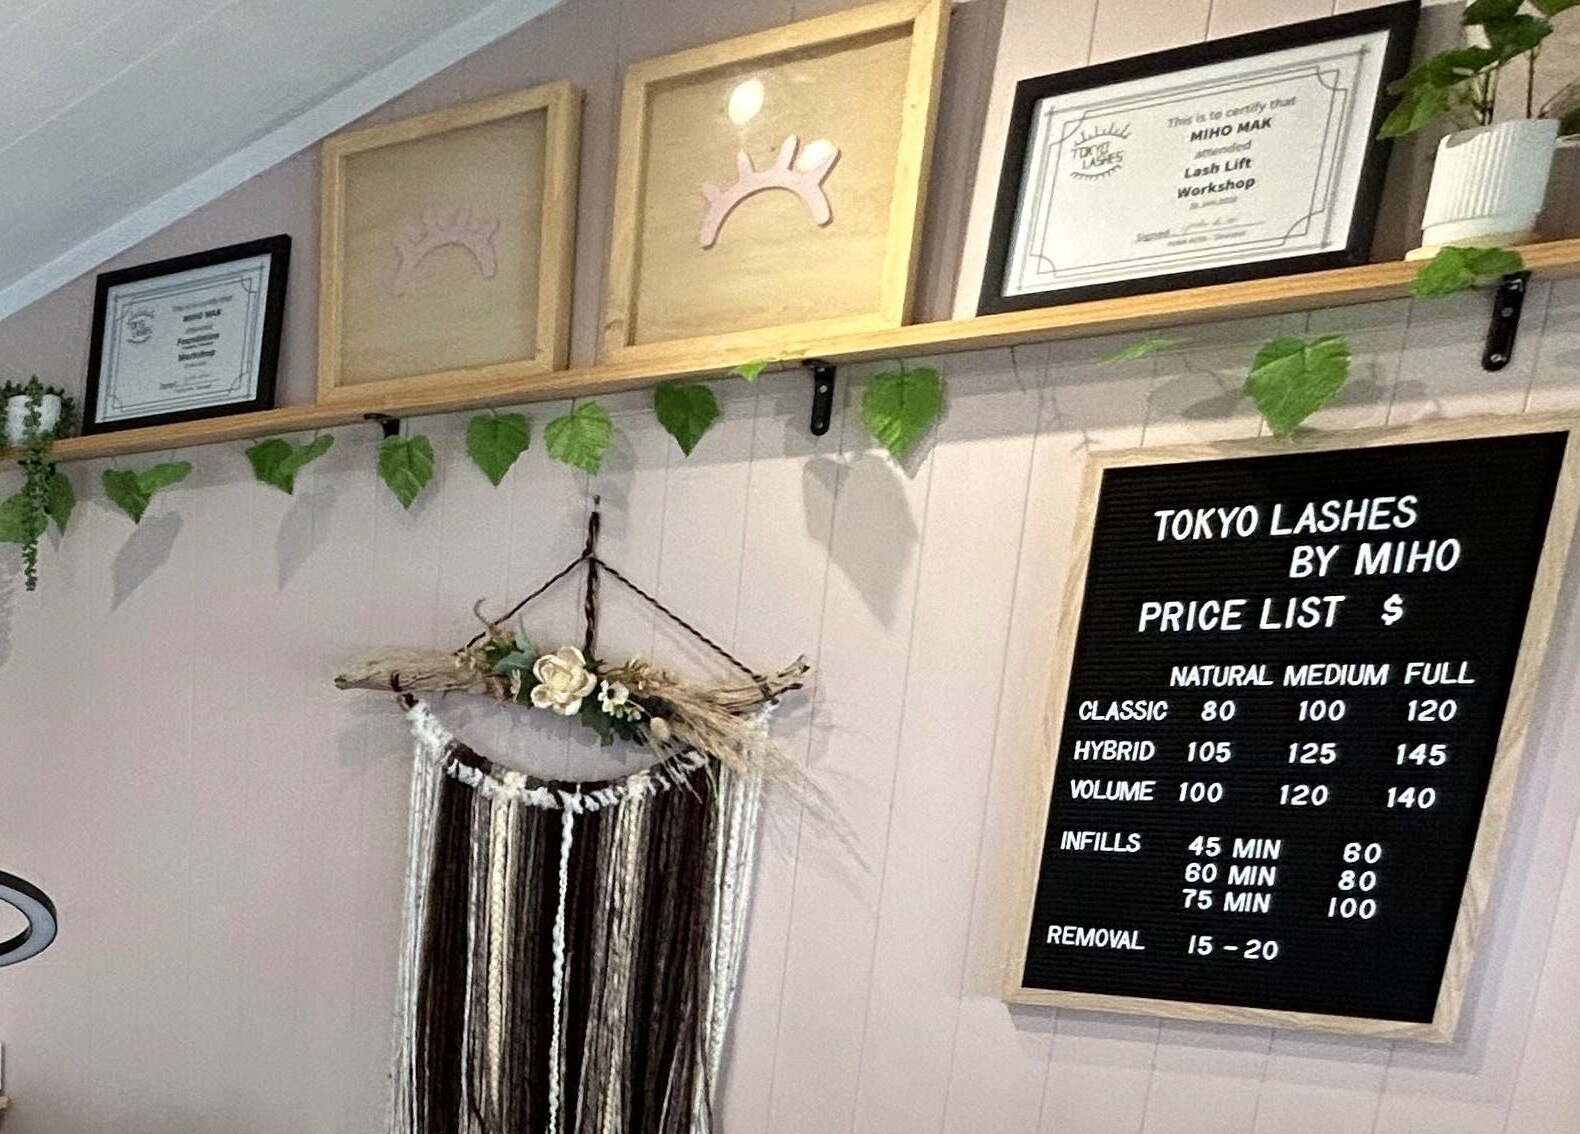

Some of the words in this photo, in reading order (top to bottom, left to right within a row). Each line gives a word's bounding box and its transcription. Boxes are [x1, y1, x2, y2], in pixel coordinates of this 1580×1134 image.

[1168, 116, 1193, 128] This
[1196, 112, 1206, 123] is
[1210, 110, 1222, 120] to
[1189, 125, 1233, 143] MIHO
[1236, 117, 1272, 134] MAK
[1070, 141, 1110, 159] TOKYO
[1184, 163, 1220, 179] Lash
[1224, 157, 1252, 172] Lift
[1177, 177, 1256, 199] Workshop
[1154, 505, 1258, 541] TOKYO
[1270, 495, 1417, 535] LASHES
[1290, 545, 1340, 577] BY
[1355, 539, 1460, 575] MIHO
[1139, 599, 1247, 632] PRICE
[1260, 596, 1346, 629] LIST
[1381, 594, 1403, 625] $
[1170, 665, 1273, 687] NATURAL
[1283, 664, 1389, 686] MEDIUM
[1404, 661, 1475, 685] FULL
[1079, 700, 1168, 720] CLASSIC
[1201, 701, 1235, 721] 80
[1299, 700, 1345, 721] 100
[1408, 700, 1457, 721] 120
[1074, 740, 1155, 761] HYBRID
[1188, 741, 1231, 762] 105
[1289, 743, 1336, 764] 125
[1397, 744, 1446, 765] 145
[1071, 780, 1156, 801] VOLUME
[1180, 782, 1223, 802] 100
[1280, 785, 1328, 805] 120
[1388, 787, 1435, 808] 140
[1061, 831, 1140, 852] INFILLS
[1188, 836, 1221, 857] 45
[1233, 838, 1281, 859] MIN
[1343, 843, 1381, 863] 60
[1185, 863, 1217, 883] 60
[1228, 865, 1276, 886] MIN
[1338, 870, 1376, 891] 80
[1183, 889, 1212, 909] 75
[1224, 892, 1271, 913] MIN
[1328, 897, 1376, 919] 100
[1047, 925, 1145, 949] REMOVAL
[1188, 935, 1212, 955] 15
[1244, 939, 1278, 960] 20
